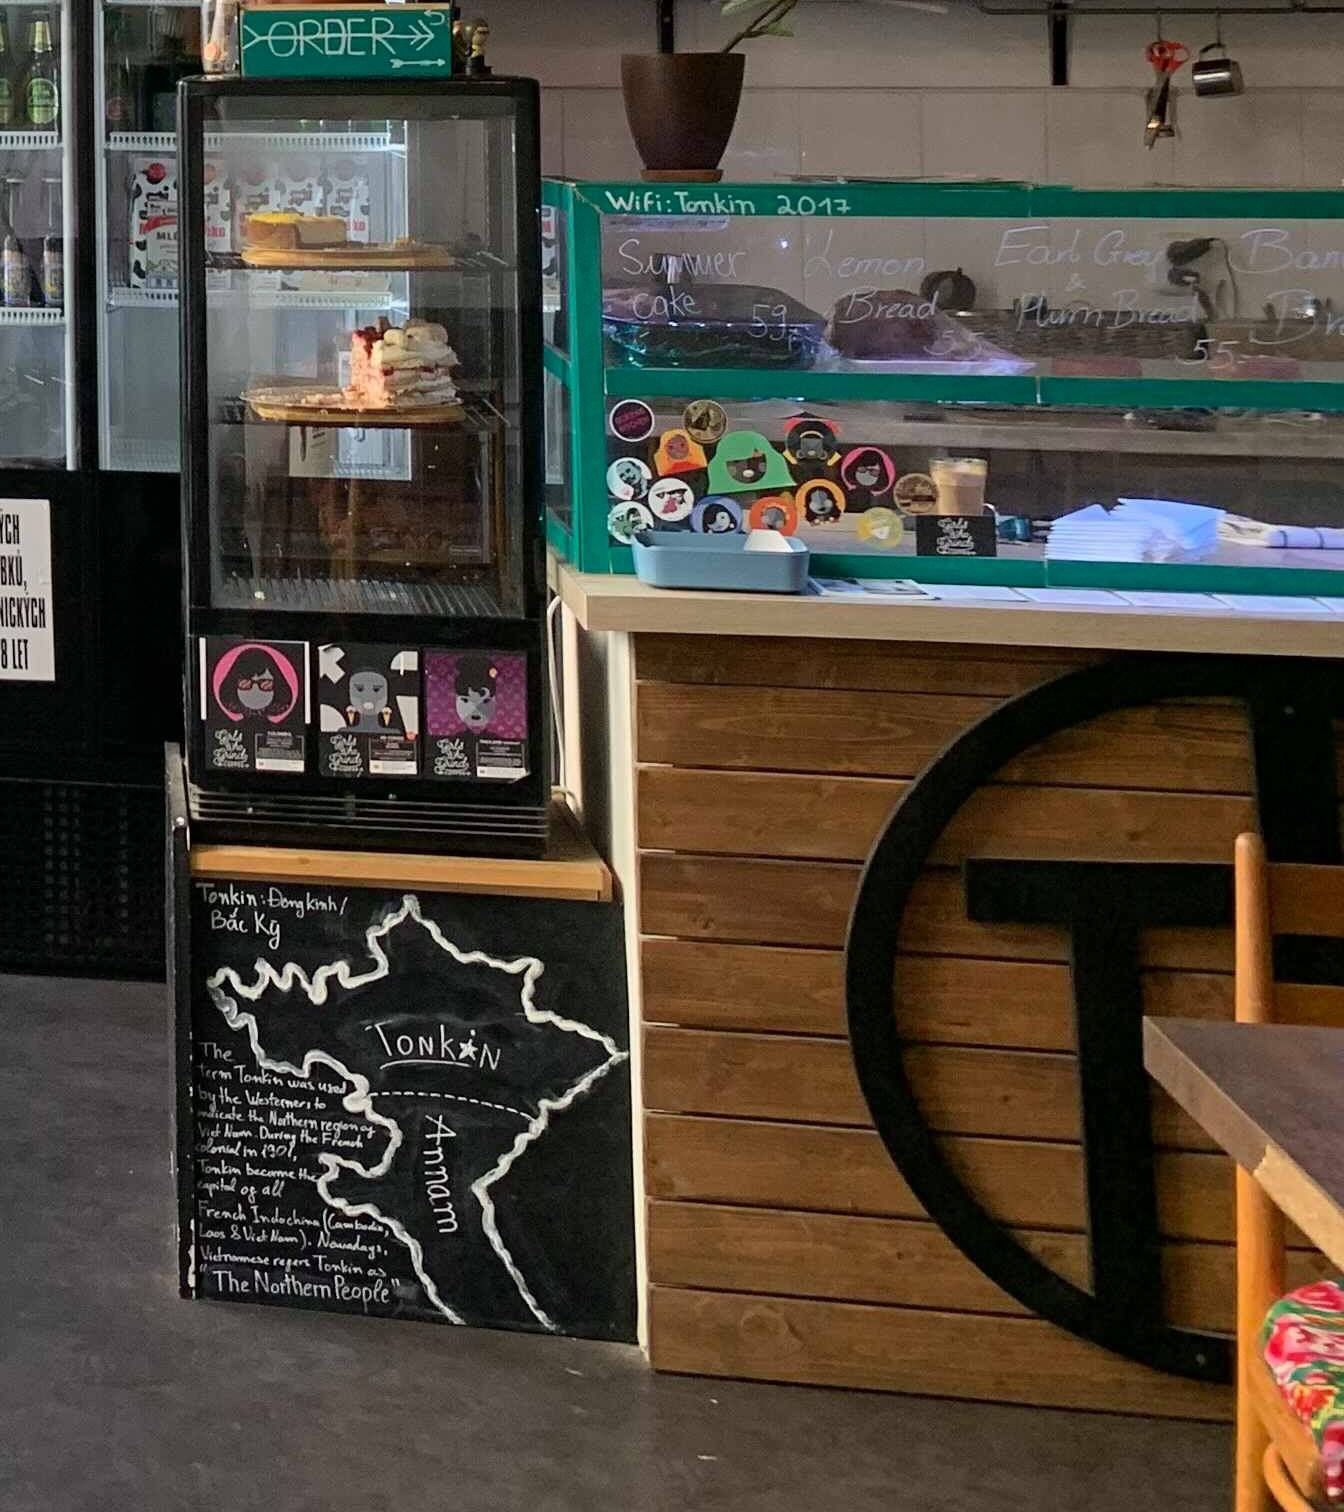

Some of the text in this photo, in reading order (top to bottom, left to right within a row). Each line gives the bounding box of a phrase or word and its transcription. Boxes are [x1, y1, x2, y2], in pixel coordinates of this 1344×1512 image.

[267, 17, 396, 57] ORDER
[673, 191, 756, 216] Tonkin
[776, 194, 853, 217] 2017
[835, 288, 940, 324] Bread
[12, 639, 30, 671] LET
[199, 1042, 234, 1062] The
[233, 1064, 284, 1087] Tonkin
[288, 1080, 315, 1092] was
[198, 1084, 216, 1104] by
[218, 1085, 242, 1106] the
[314, 1096, 327, 1110] to
[249, 1109, 265, 1124] the
[320, 1119, 359, 1139] region
[300, 1129, 319, 1145] the
[243, 1146, 258, 1158] in
[197, 1158, 242, 1176] Tonkin
[262, 1179, 285, 1198] all
[198, 1199, 248, 1222] French
[198, 1222, 226, 1239] Laos
[312, 1254, 363, 1275] Tonkin
[366, 1267, 388, 1278] as
[253, 1268, 332, 1299] Northern
